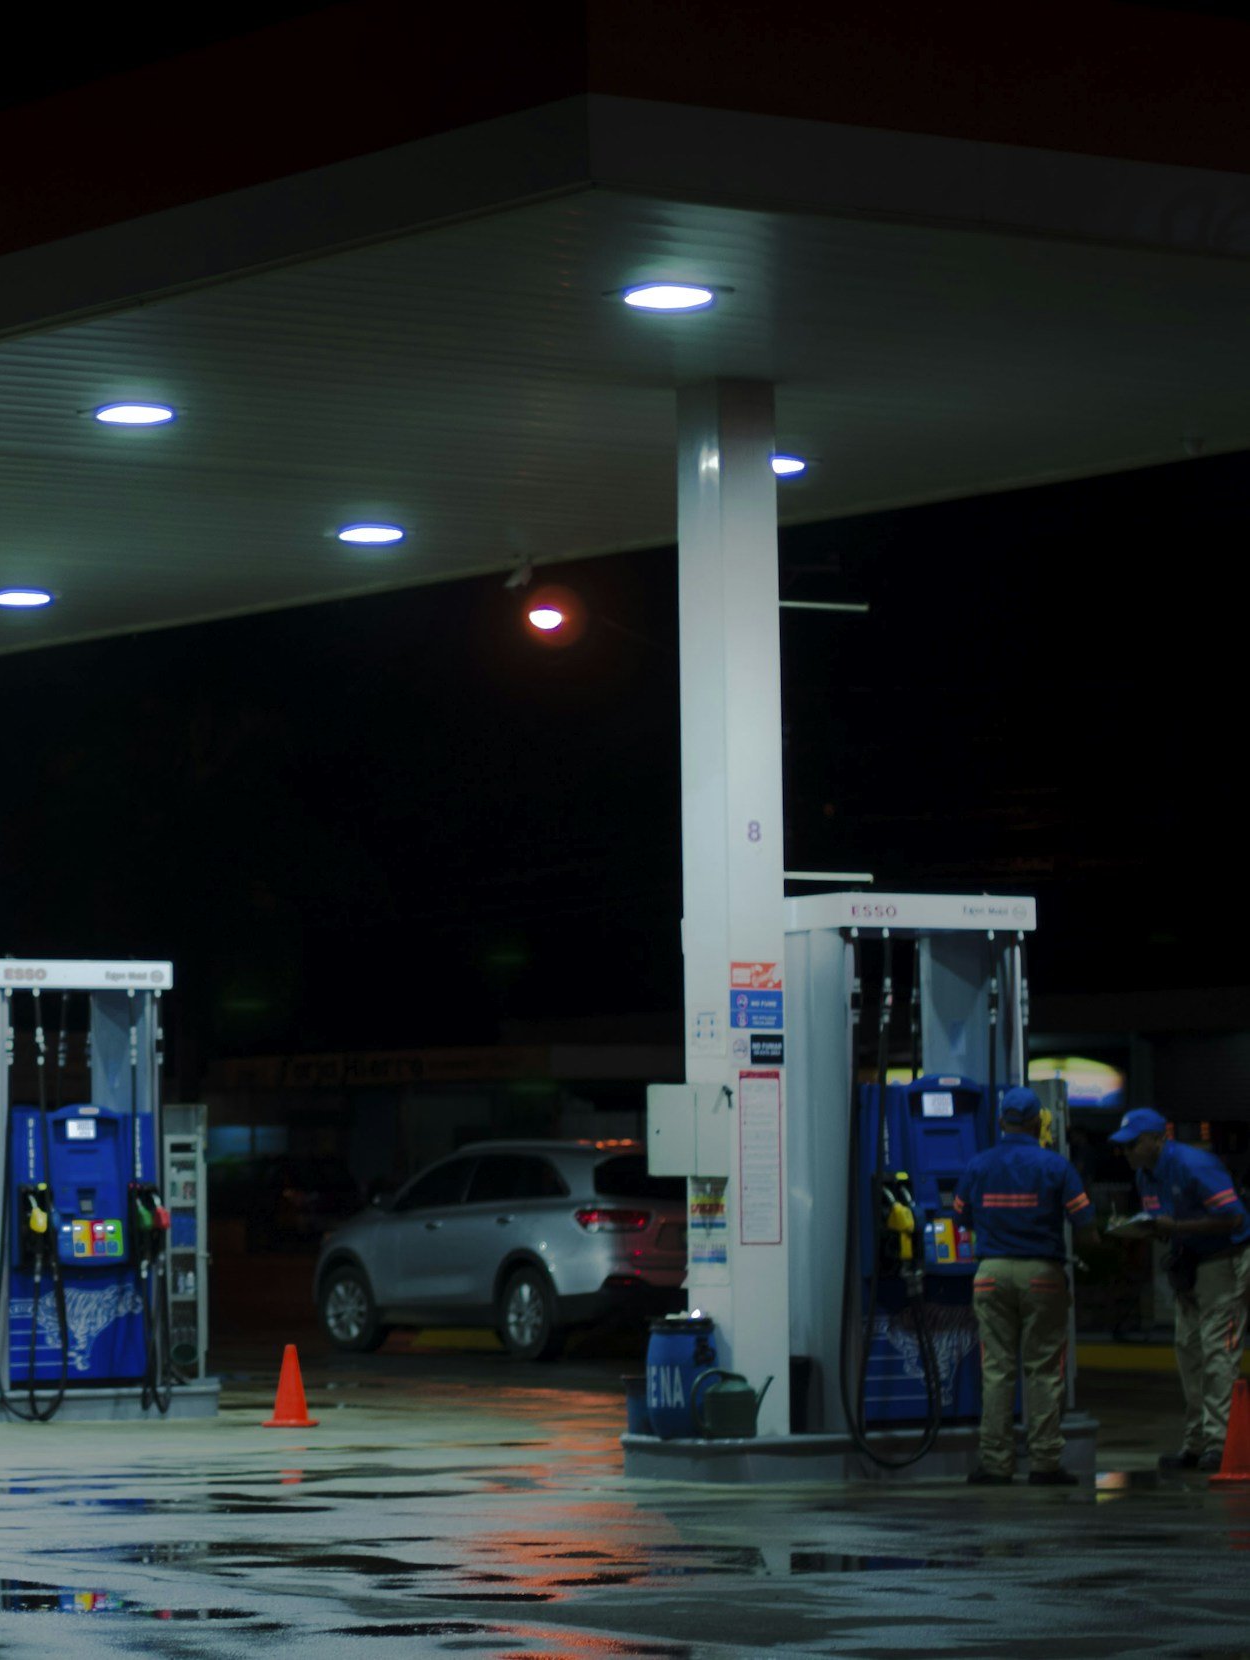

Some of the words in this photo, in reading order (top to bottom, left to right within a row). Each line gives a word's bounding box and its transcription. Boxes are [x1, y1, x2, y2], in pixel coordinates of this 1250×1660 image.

[747, 819, 761, 842] 8
[851, 904, 898, 918] ESSO
[3, 968, 47, 981] ESSO
[646, 1365, 685, 1409] ENA
